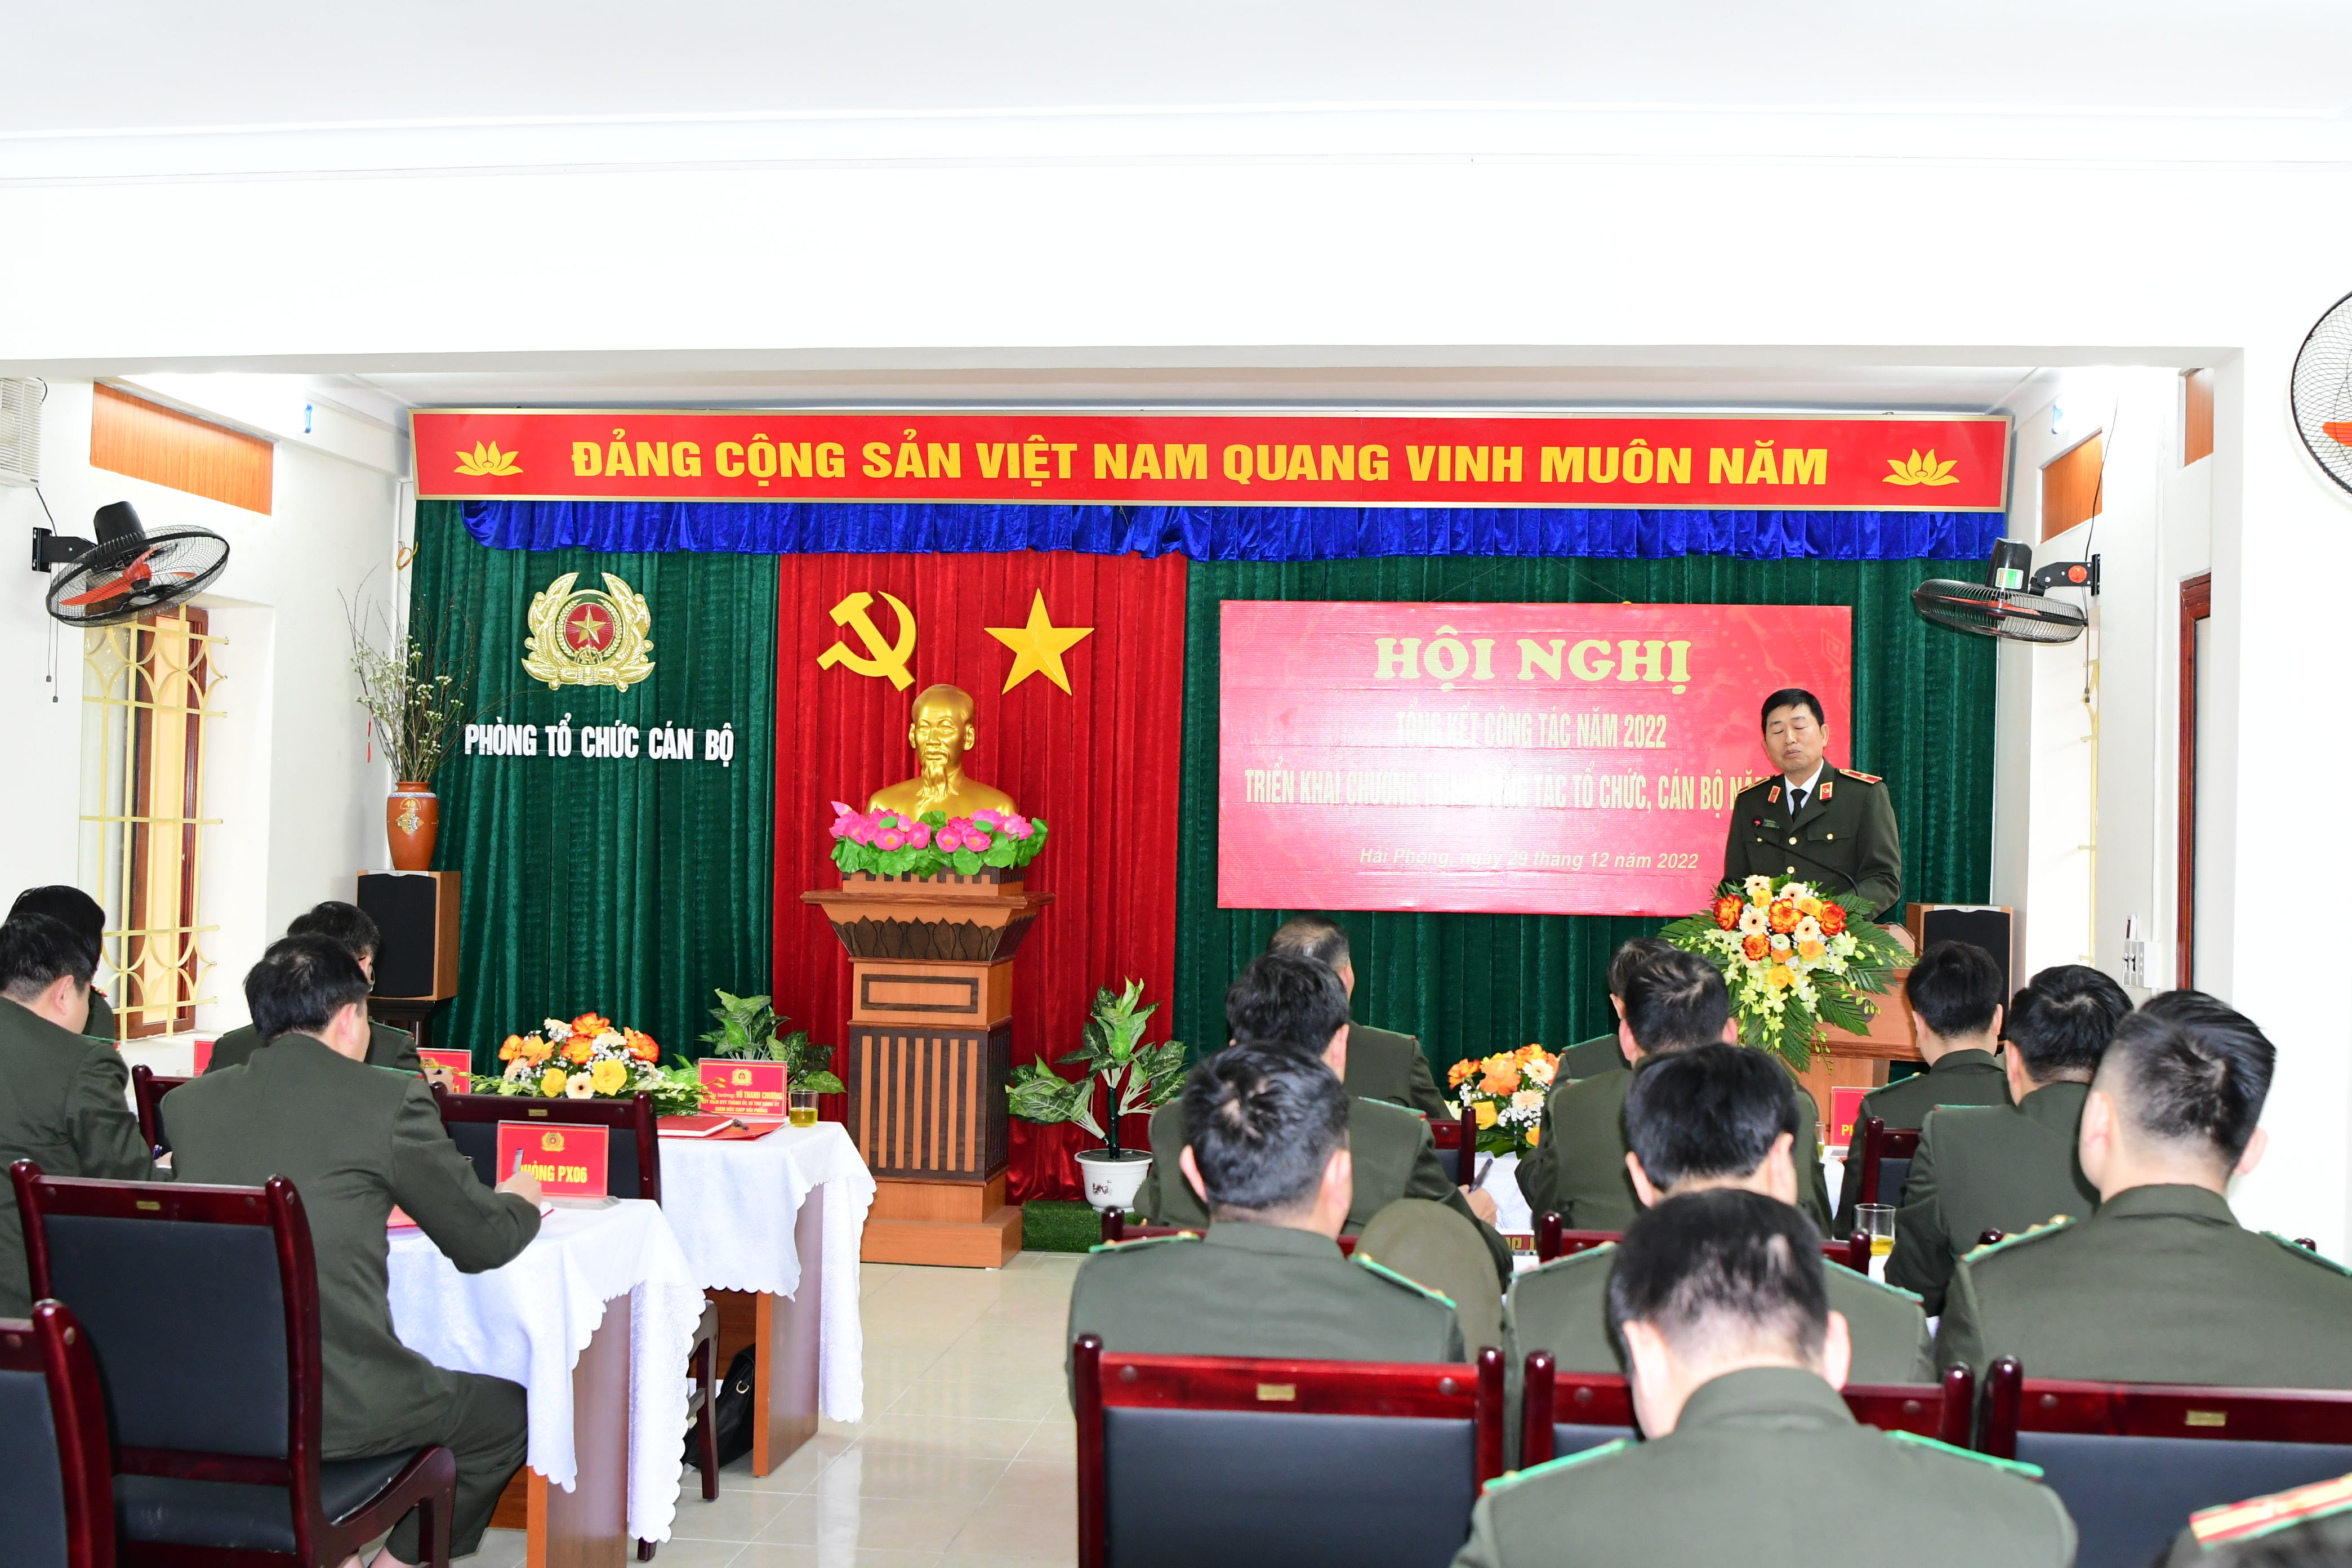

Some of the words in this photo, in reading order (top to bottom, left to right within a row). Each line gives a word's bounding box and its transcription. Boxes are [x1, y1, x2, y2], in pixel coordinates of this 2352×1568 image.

[571, 429, 702, 477] ĐẢNG
[715, 433, 845, 487] CỘNG
[862, 429, 961, 478] SẢN
[975, 434, 1077, 487] VIỆT
[1094, 444, 1208, 479] NAM
[1223, 444, 1389, 484] QUANG
[1406, 446, 1522, 483] VINH
[1540, 438, 1691, 484] MUÔN
[1709, 440, 1827, 485] NĂM
[1374, 625, 1495, 691] HỘI
[1516, 639, 1691, 694] NGHỊ
[465, 716, 537, 755] PHÒNG
[545, 712, 572, 757] TỔ
[581, 720, 639, 758] CHỨC
[649, 720, 693, 759] CÁN
[705, 723, 734, 767] BỘ
[1484, 706, 1532, 747] CÔNG
[1538, 706, 1571, 747] TÁC
[1577, 706, 1618, 747] NĂM
[1624, 714, 1666, 748] 2022
[1245, 756, 1294, 803] TRIỂN
[1300, 770, 1340, 804] KHAI
[1534, 767, 1567, 807] TÁC
[1572, 761, 1593, 808] TỔ
[1600, 768, 1652, 813] CHỨC,
[1658, 769, 1694, 809] CÁN
[1700, 768, 1723, 818] BỘ
[1359, 845, 1387, 863] Hải
[1534, 851, 1583, 870] tháng
[1592, 852, 1610, 867] 12
[1614, 852, 1651, 868] năm
[1658, 853, 1699, 869] 2022
[558, 1165, 587, 1183] PX06
